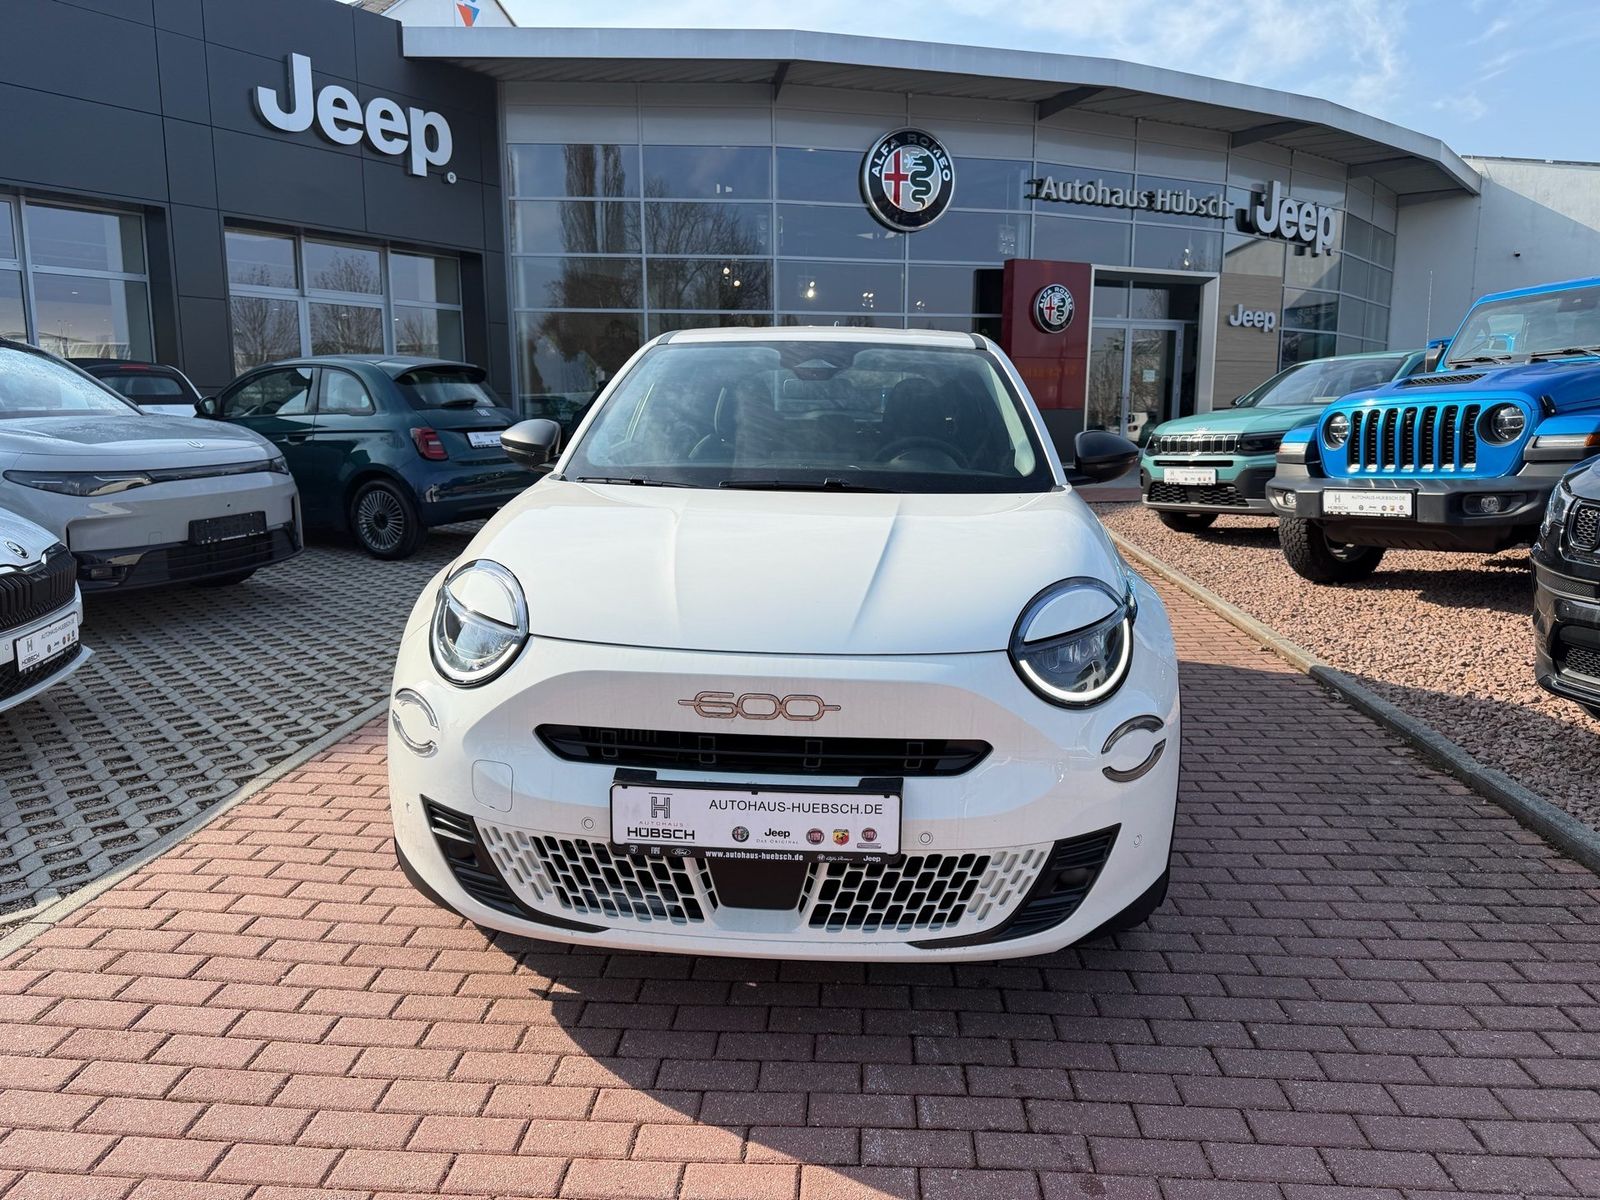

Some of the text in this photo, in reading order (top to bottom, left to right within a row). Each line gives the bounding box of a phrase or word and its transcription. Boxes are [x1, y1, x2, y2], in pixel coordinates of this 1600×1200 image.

[255, 52, 453, 177] Jeep
[871, 133, 951, 182] ALFA ROMEO
[1039, 176, 1230, 218] Autohaus Hübsch
[1256, 180, 1337, 254] Jeep
[1039, 286, 1073, 310] ALFA ROMEO
[1229, 303, 1277, 333] Jeep
[692, 690, 826, 722] 600
[709, 799, 883, 815] AUTOHAUS-HUEBSCH.DE
[627, 827, 696, 840] HÜBSCH
[764, 828, 791, 838] Jeep
[705, 850, 804, 861] www.autohaus-huebsch.de
[863, 855, 881, 863] Jeep
